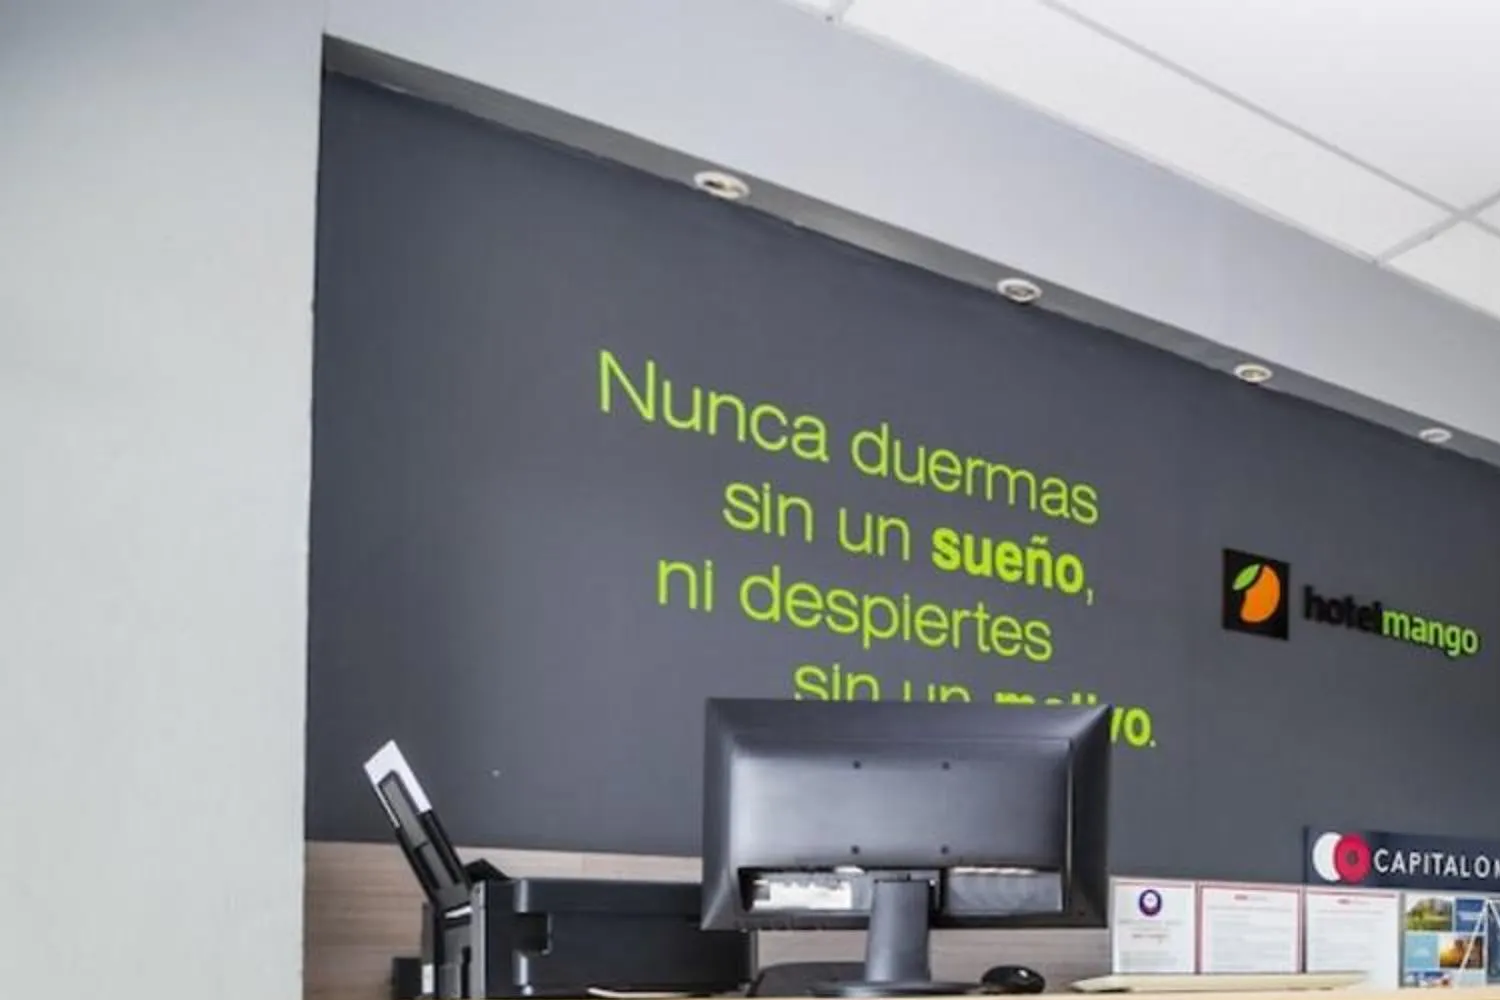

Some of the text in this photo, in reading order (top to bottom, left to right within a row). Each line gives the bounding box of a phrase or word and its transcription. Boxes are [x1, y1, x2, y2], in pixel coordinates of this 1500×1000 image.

[599, 349, 1099, 526] Nunca duermas
[722, 481, 1095, 606] sin un sueño,
[657, 559, 1054, 662] ni despiertes
[1373, 849, 1469, 878] CAPITAL
